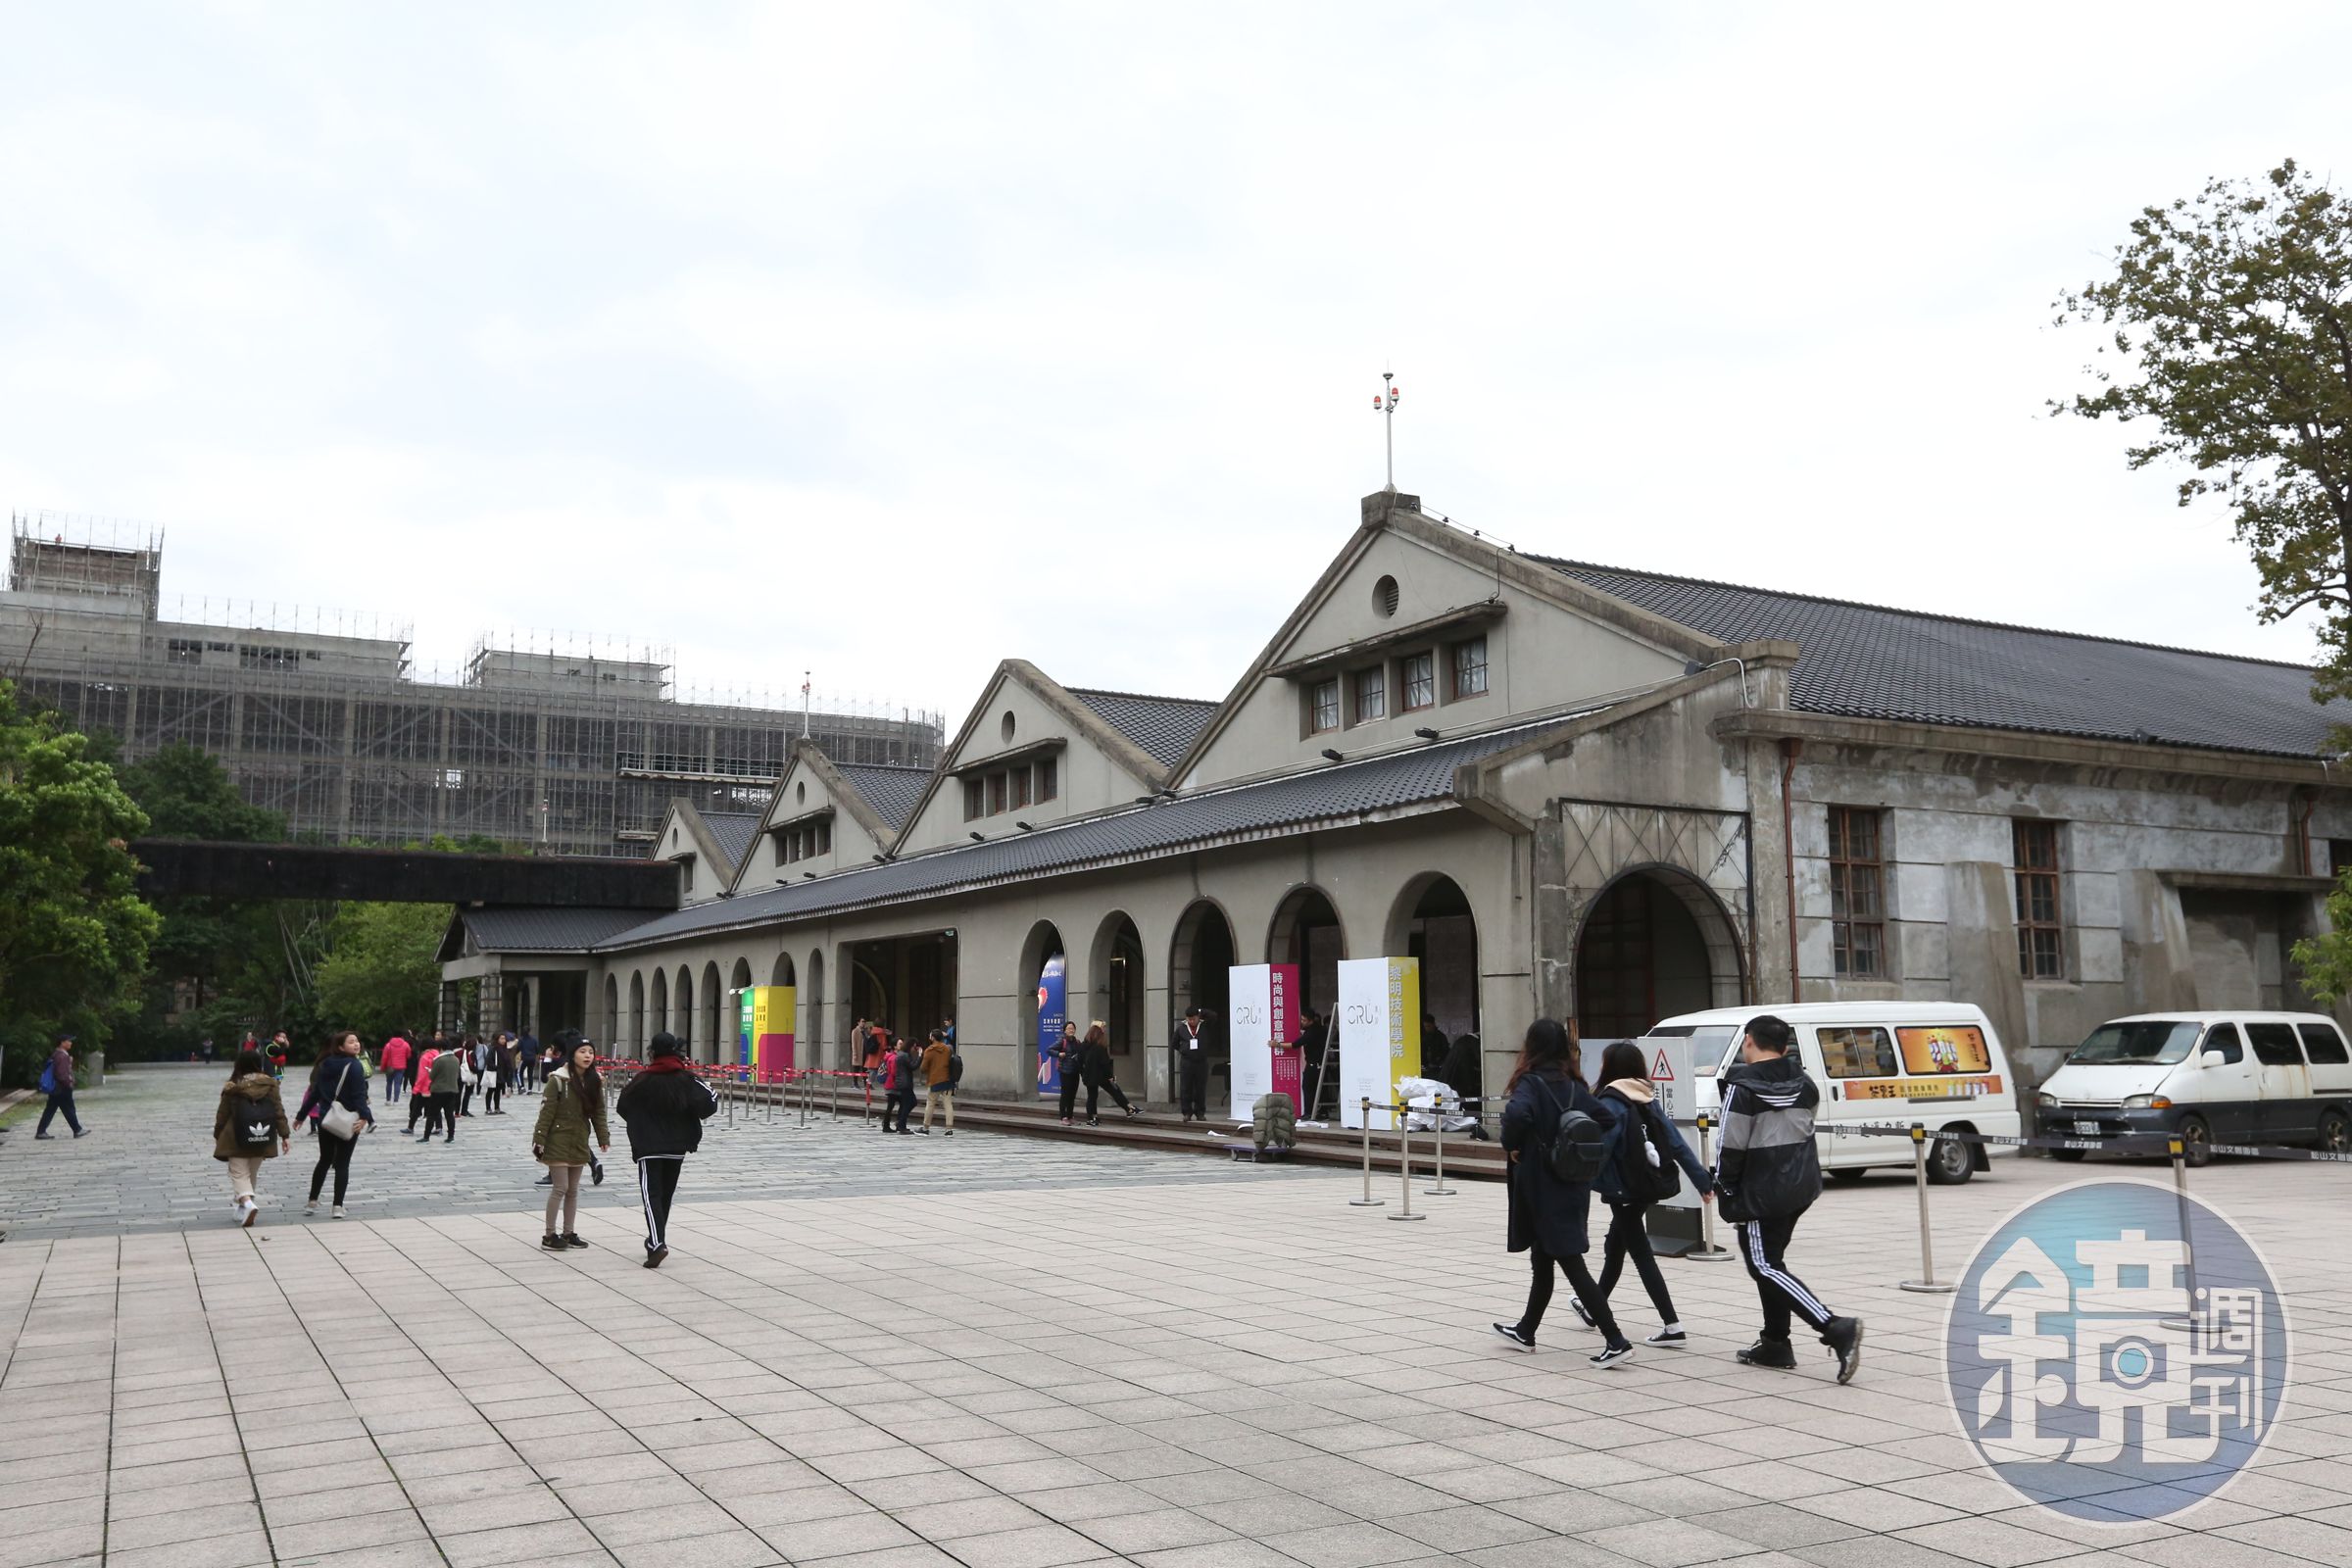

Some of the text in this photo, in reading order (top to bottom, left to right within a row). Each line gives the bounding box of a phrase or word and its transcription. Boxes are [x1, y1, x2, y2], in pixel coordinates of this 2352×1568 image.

[1390, 965, 1403, 1057] 黎明技術學院
